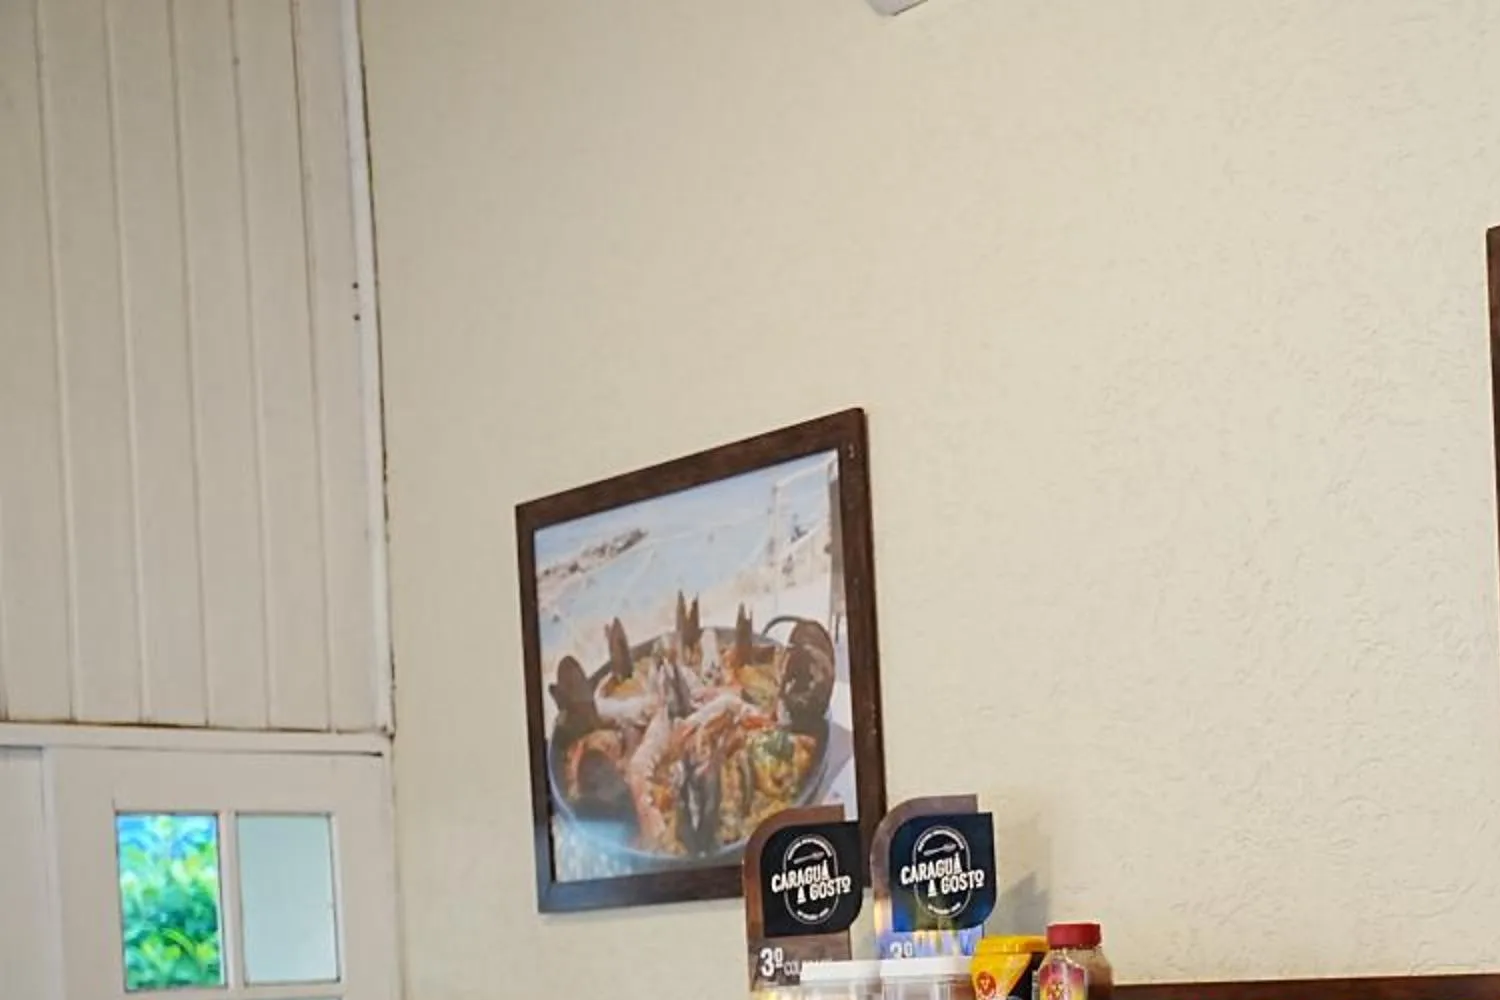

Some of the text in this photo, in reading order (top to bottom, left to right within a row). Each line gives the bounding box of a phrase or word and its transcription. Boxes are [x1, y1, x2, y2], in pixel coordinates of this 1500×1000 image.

[771, 859, 830, 893] CARAGUÁ
[900, 852, 962, 885] CARAGUÁ
[941, 869, 985, 894] GOSTO
[809, 875, 852, 901] GOSTO
